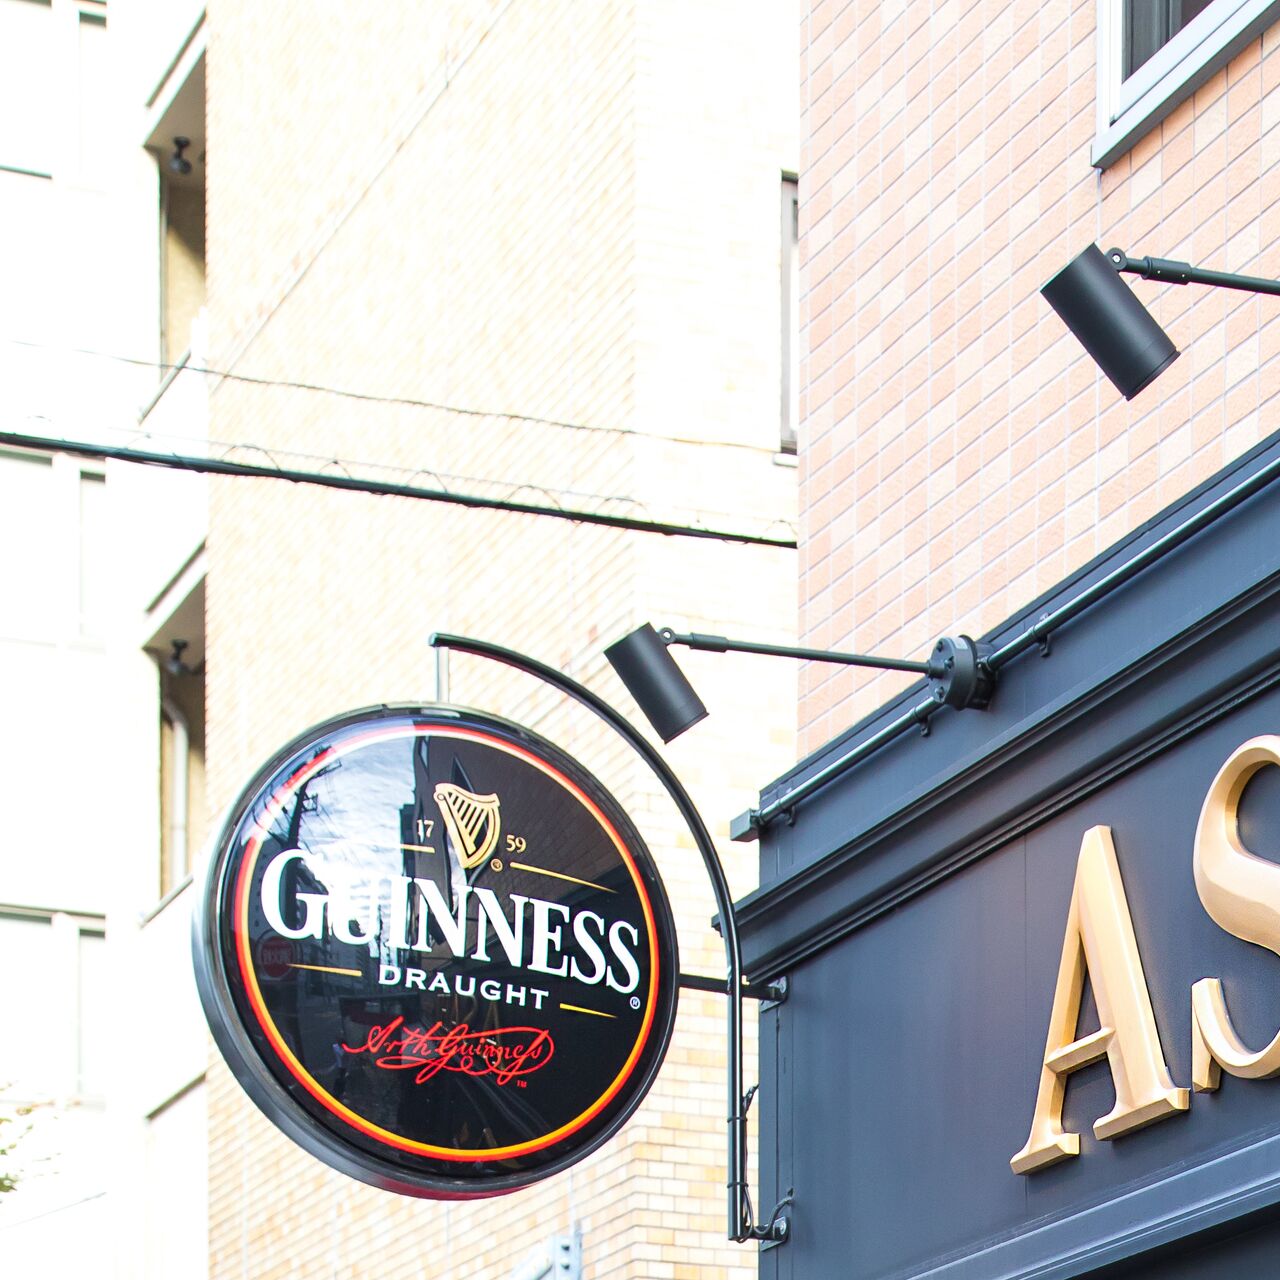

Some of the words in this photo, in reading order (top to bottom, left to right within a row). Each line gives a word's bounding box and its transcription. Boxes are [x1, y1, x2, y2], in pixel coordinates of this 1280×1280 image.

[416, 819, 435, 838] 17
[505, 834, 528, 854] 59
[261, 849, 640, 994] GUINNESS
[378, 964, 550, 1010] DRAUGHT
